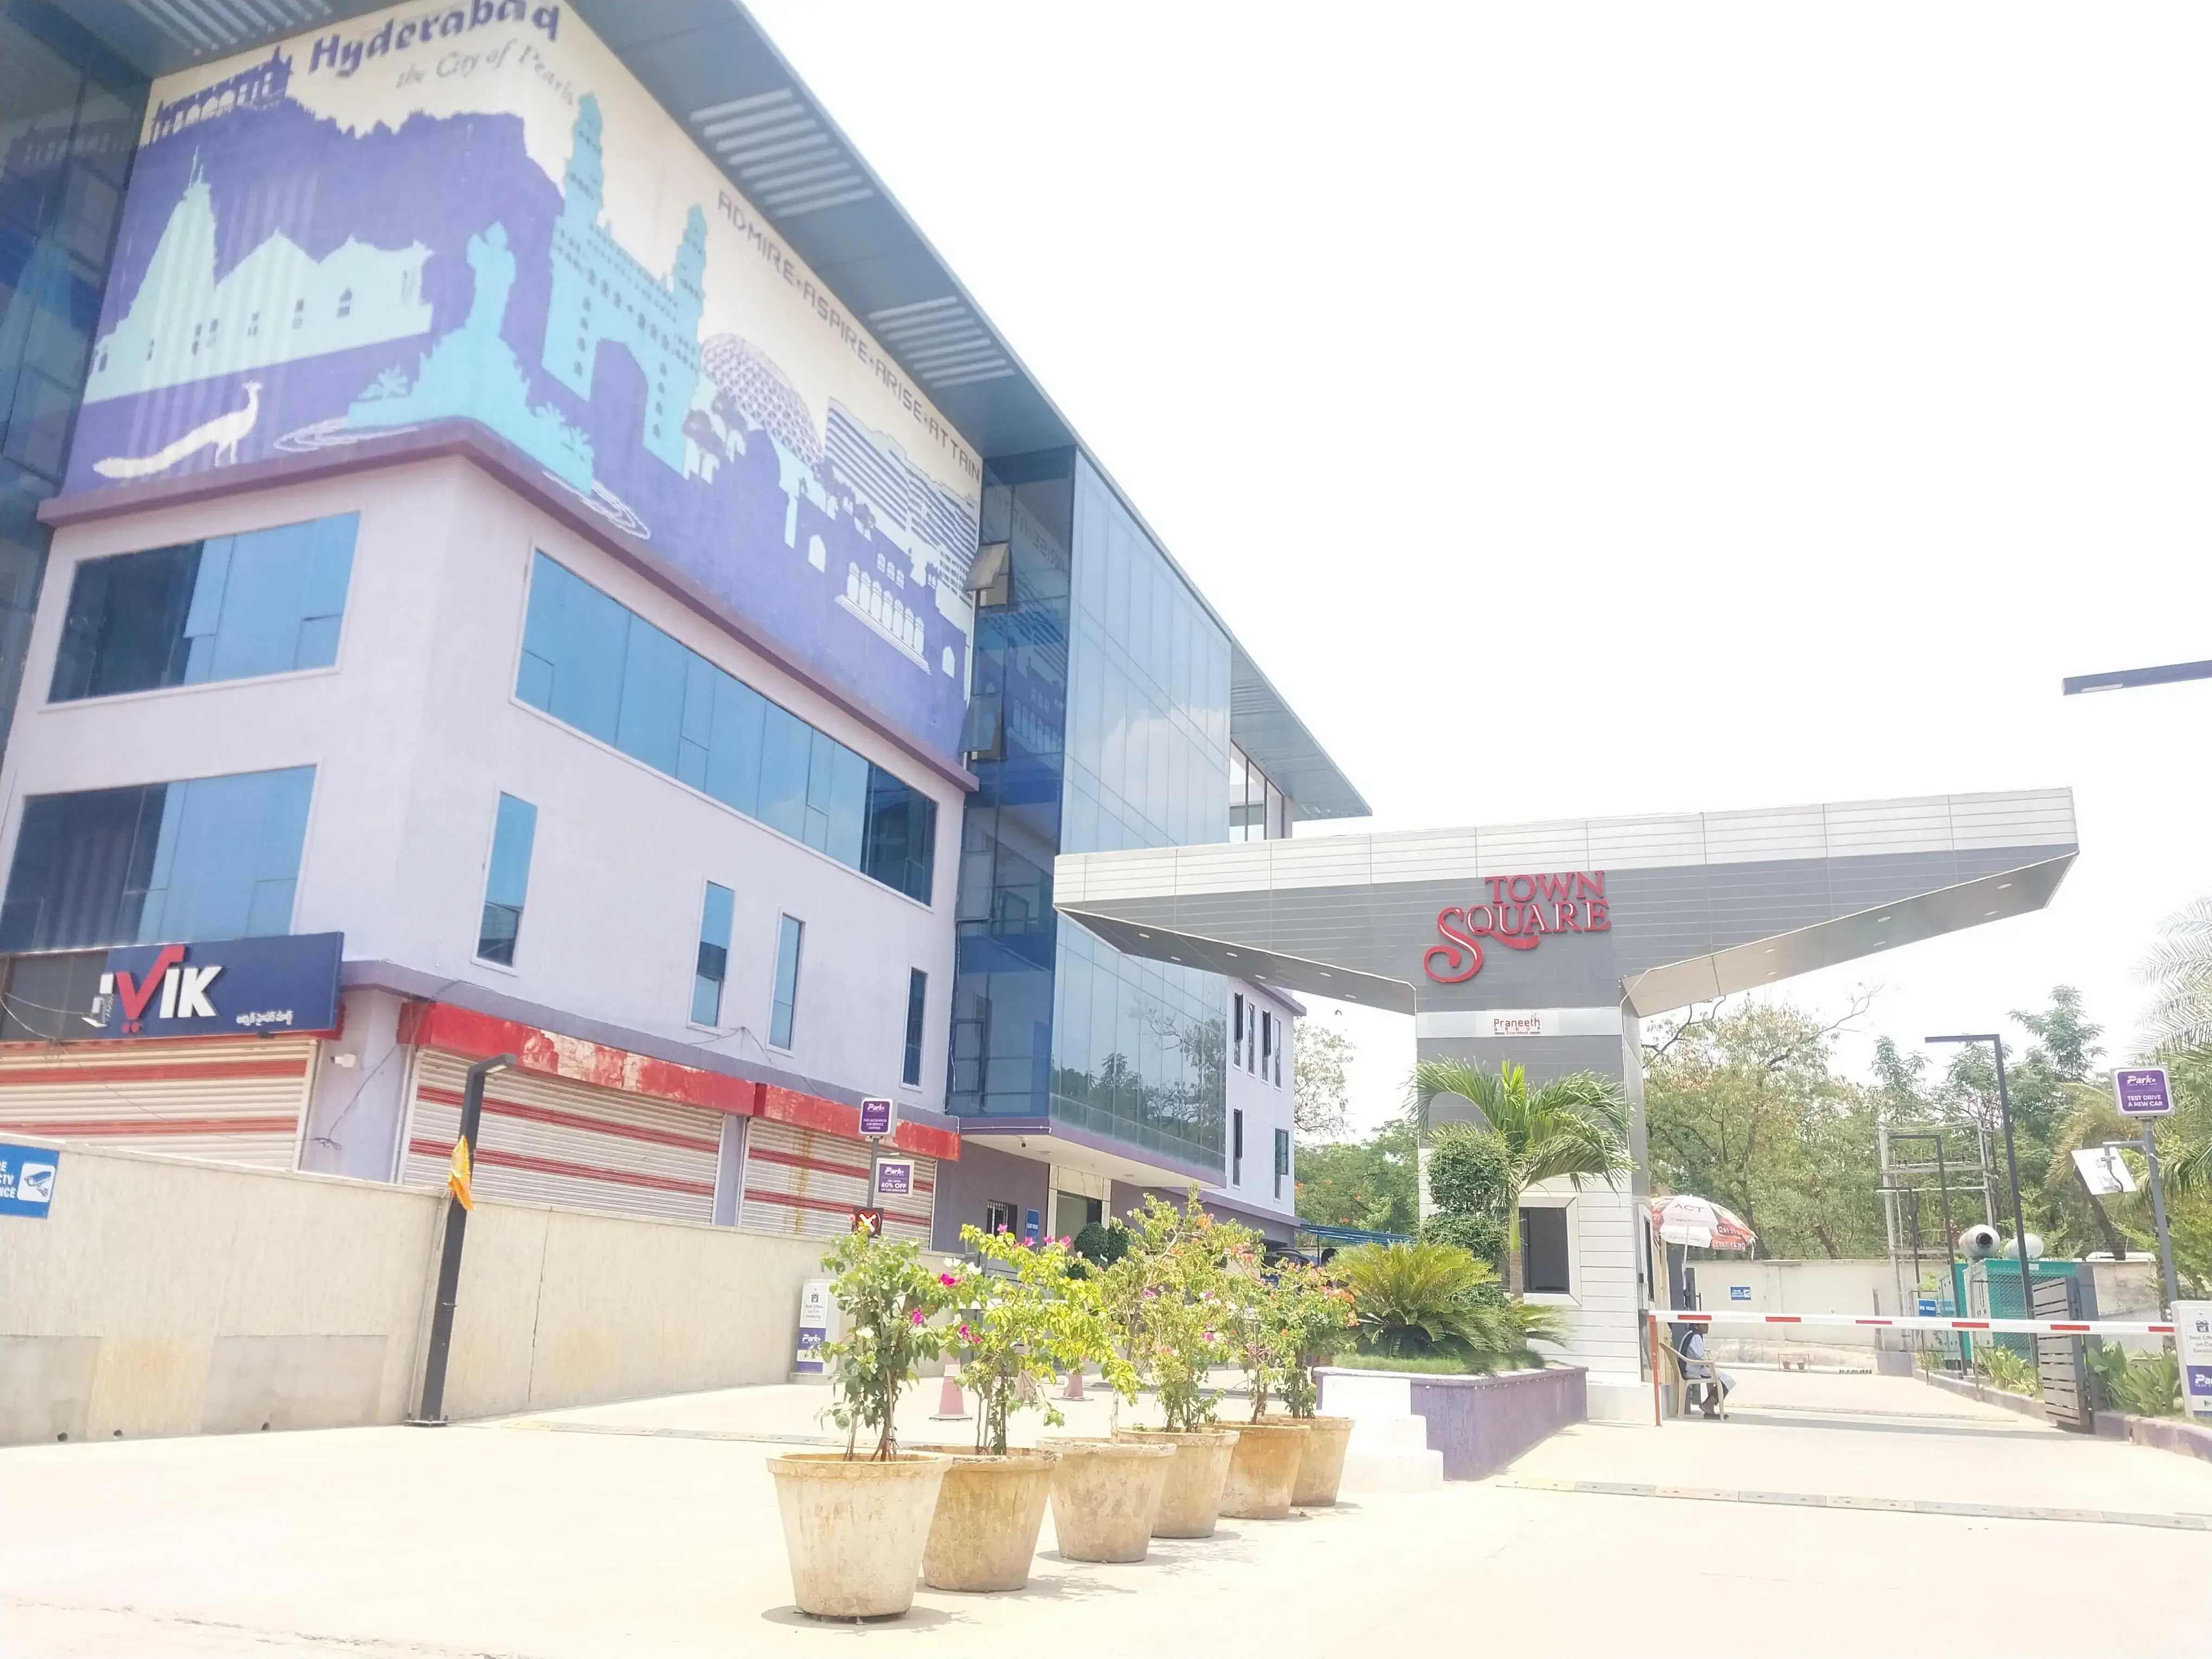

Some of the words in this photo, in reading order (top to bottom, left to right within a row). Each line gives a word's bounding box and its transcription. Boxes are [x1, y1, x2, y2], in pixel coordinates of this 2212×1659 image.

[1484, 871, 1605, 903] TOWN
[1424, 899, 1611, 983] SQUARE
[1494, 1018, 1540, 1027] Praneeth
